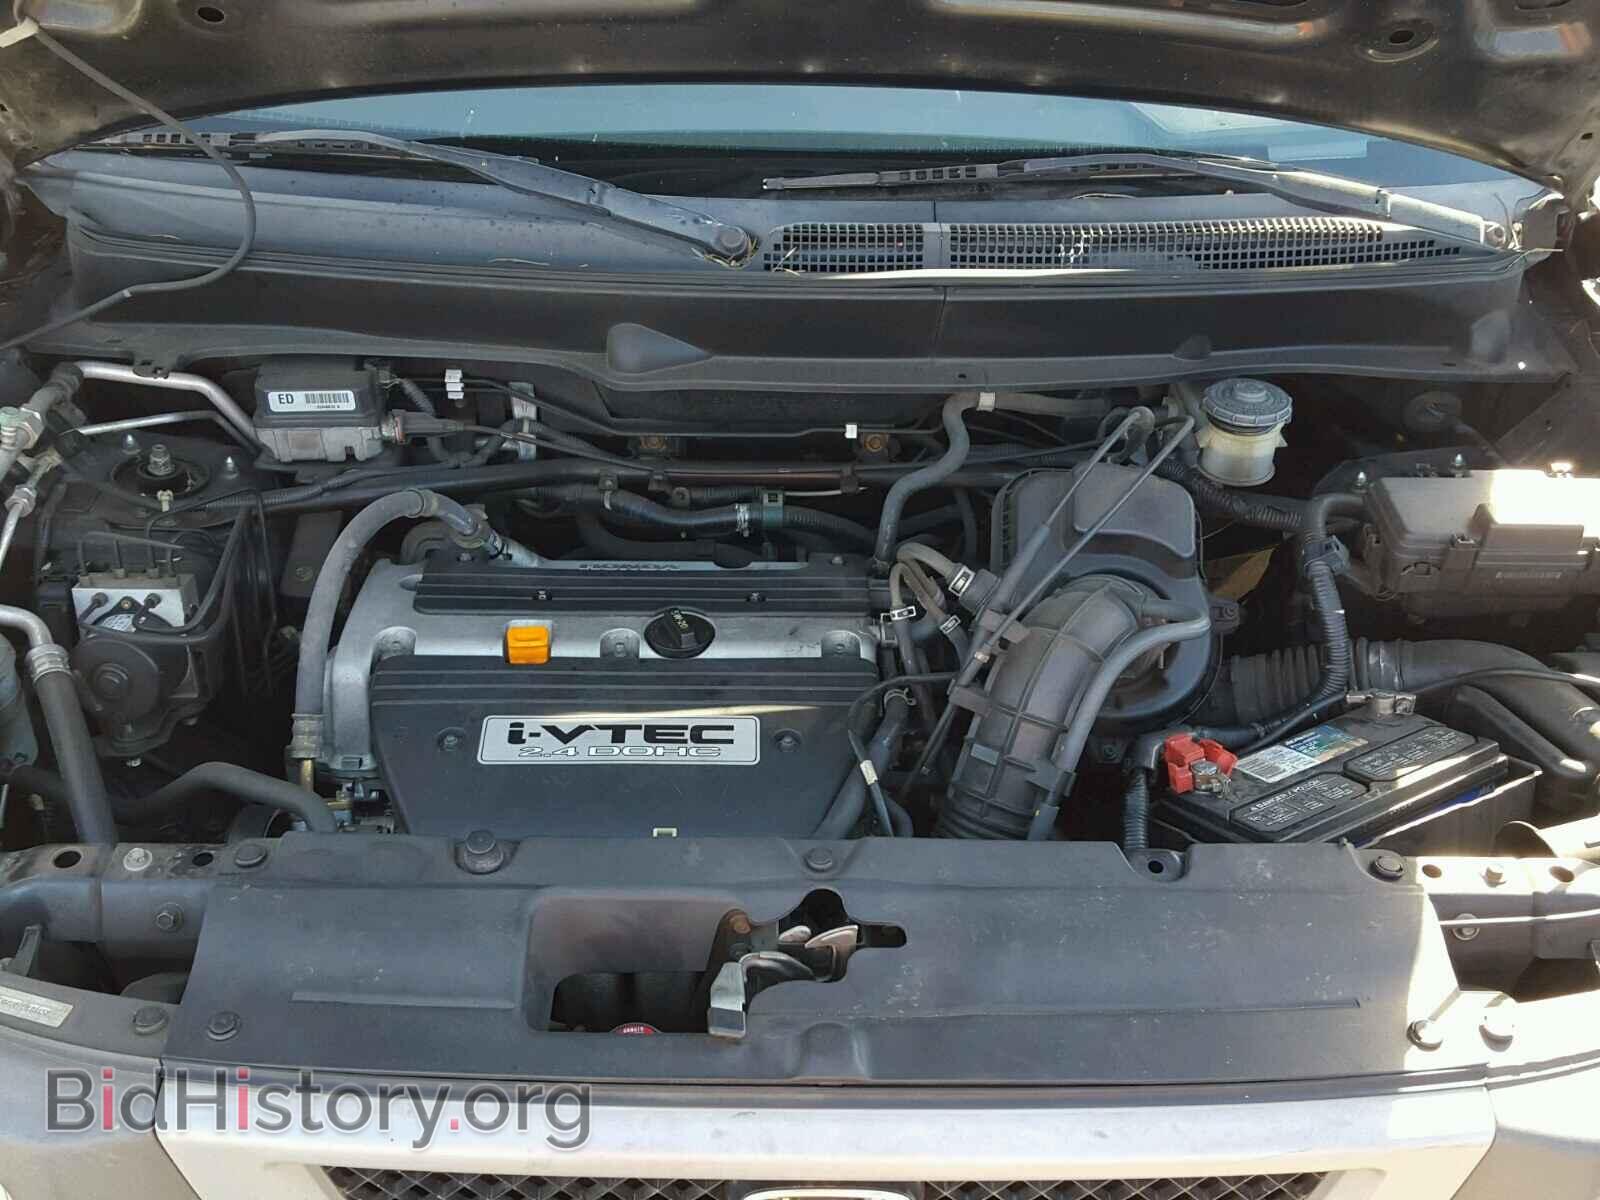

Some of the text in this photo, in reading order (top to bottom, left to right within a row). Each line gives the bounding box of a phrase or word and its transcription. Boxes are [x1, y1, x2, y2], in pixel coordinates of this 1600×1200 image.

[278, 393, 294, 404] ED
[508, 722, 734, 745] i-VTEC
[519, 746, 721, 758] 2.4 DOHC
